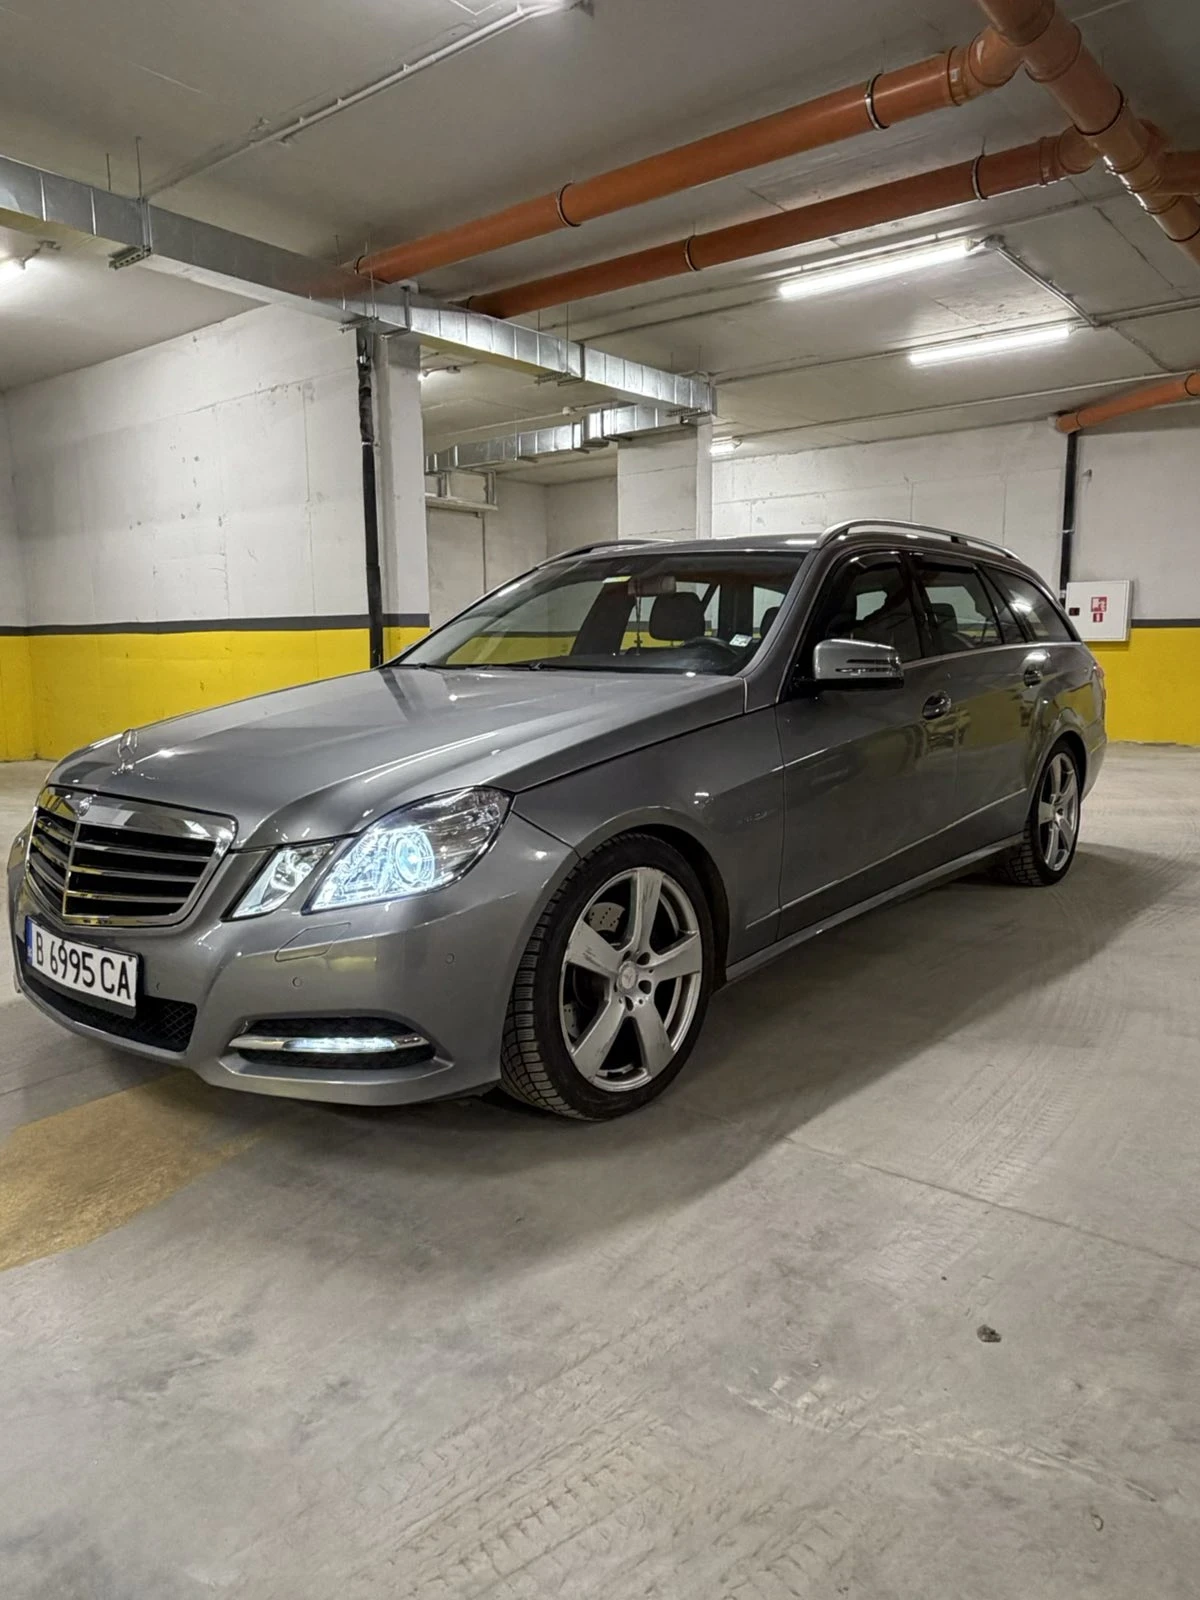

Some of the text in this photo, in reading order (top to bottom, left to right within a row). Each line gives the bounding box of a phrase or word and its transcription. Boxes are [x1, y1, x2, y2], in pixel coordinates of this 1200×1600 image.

[36, 931, 131, 1000] B 6995 CA
